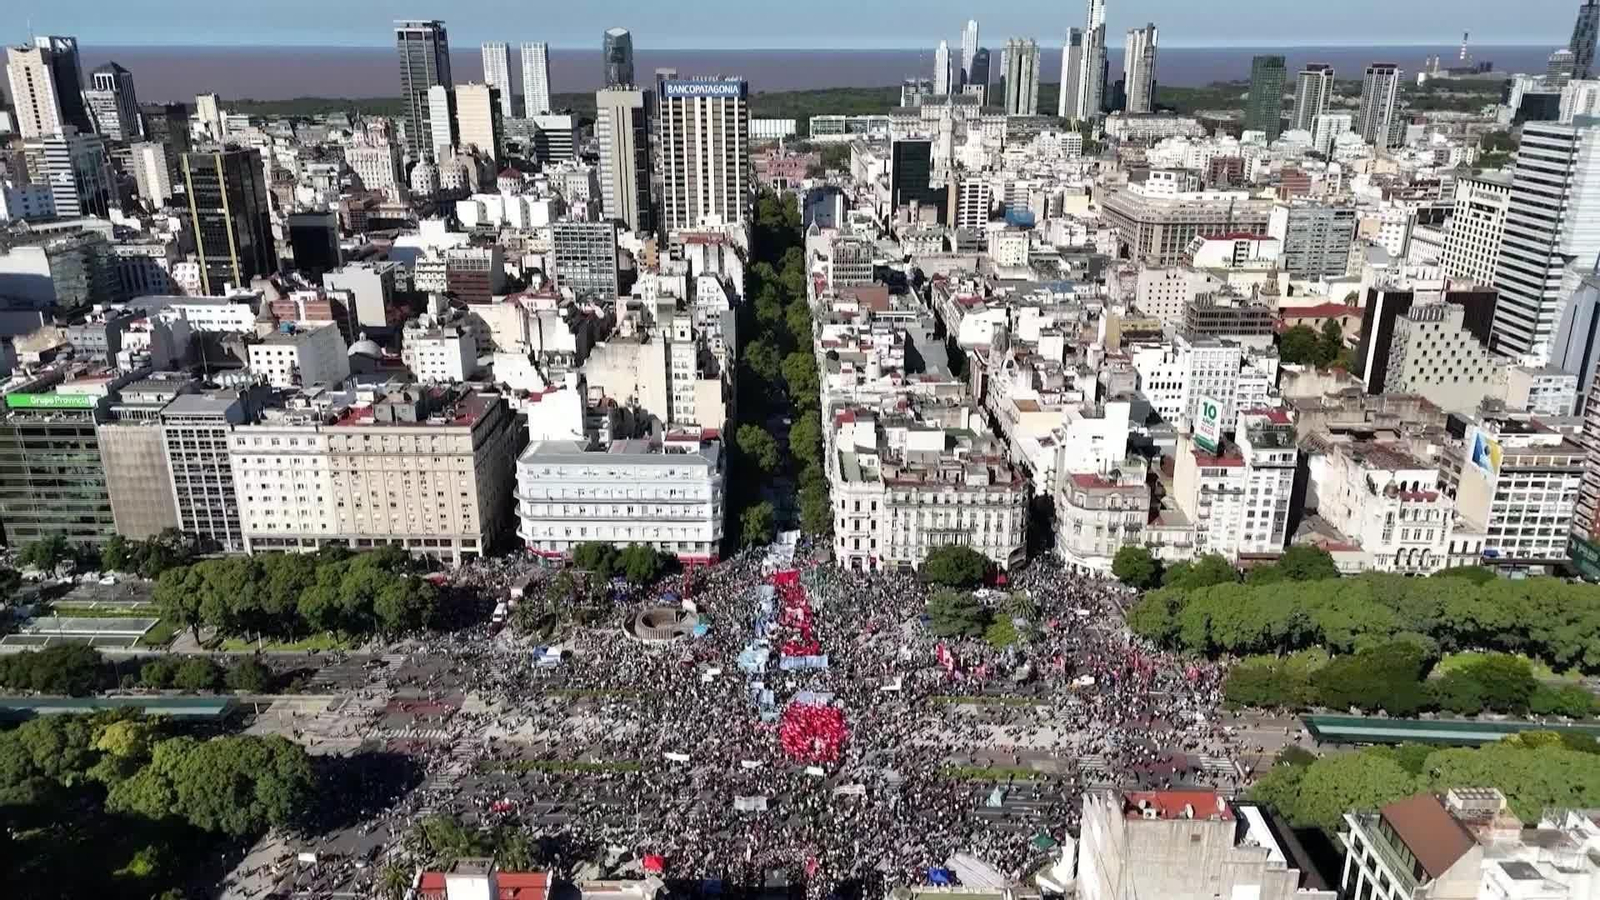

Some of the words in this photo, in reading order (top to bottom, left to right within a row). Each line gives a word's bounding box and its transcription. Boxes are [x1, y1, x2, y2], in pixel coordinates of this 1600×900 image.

[30, 396, 54, 405] Grupo
[54, 396, 89, 405] Provincia
[1203, 402, 1217, 420] 10
